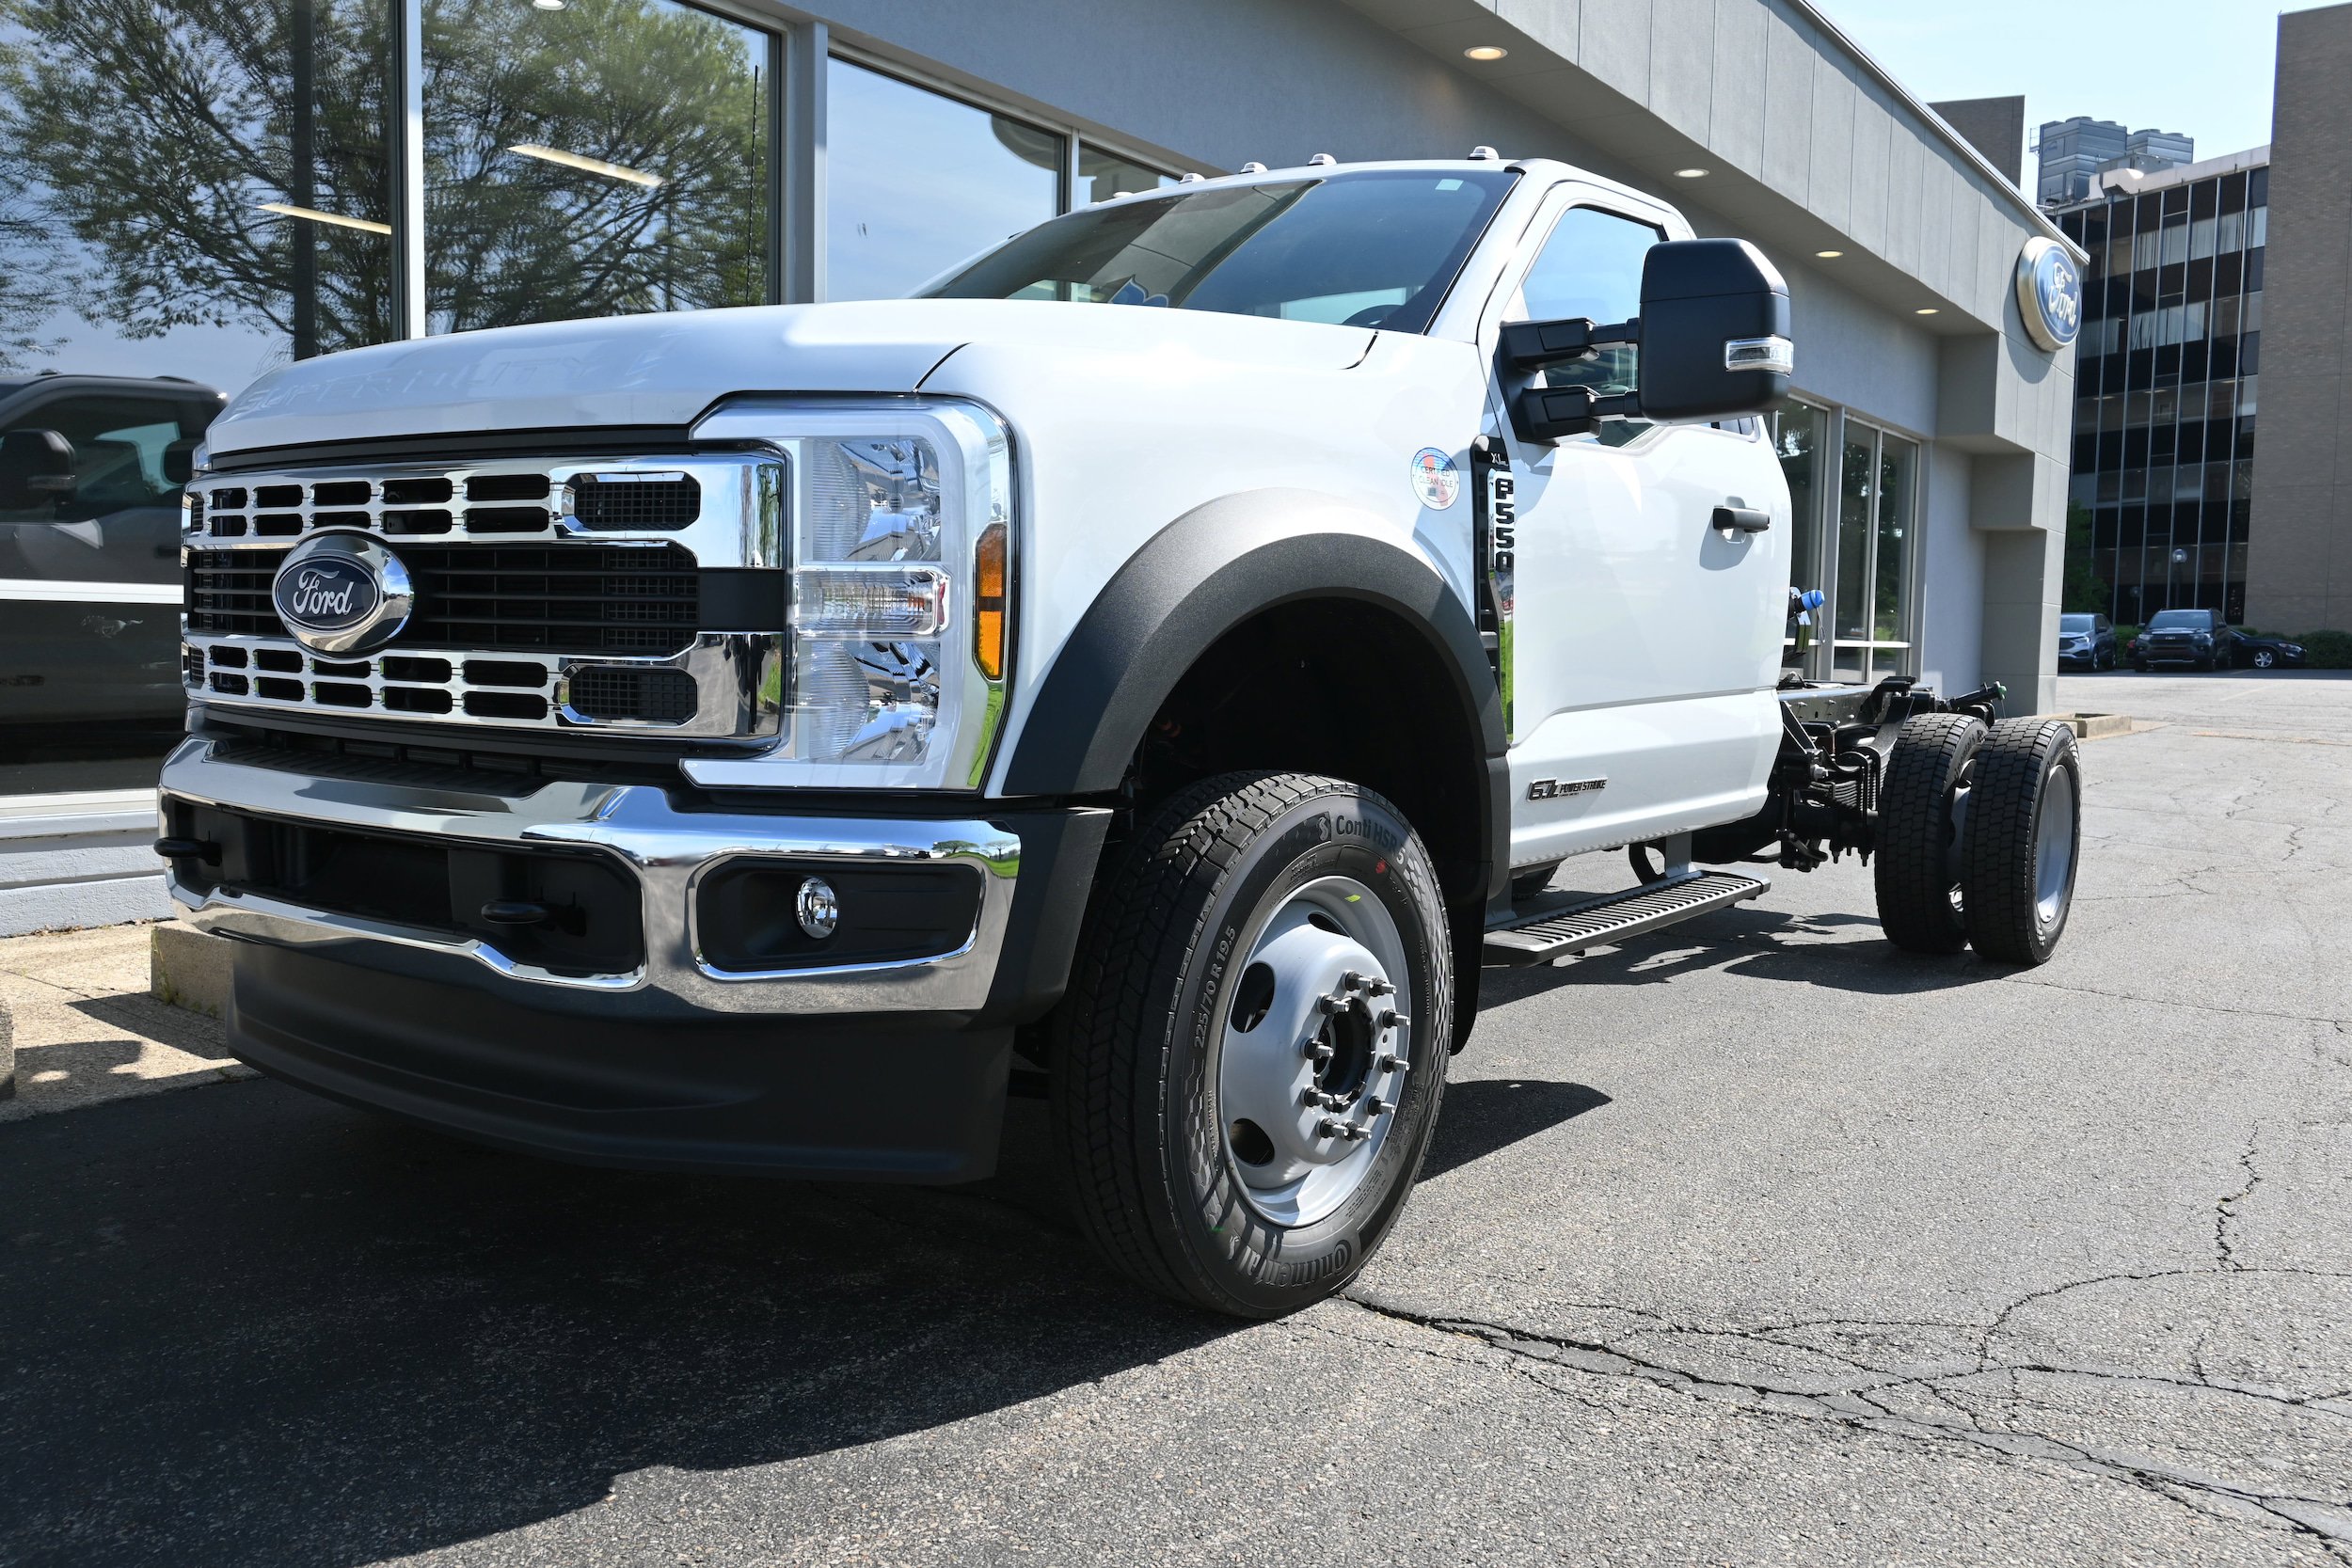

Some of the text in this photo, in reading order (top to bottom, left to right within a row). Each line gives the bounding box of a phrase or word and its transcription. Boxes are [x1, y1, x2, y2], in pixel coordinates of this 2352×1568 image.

[2048, 261, 2077, 327] Ford
[293, 567, 354, 616] Ford
[1336, 815, 1372, 839] Conti
[1194, 926, 1236, 1049] 225/70 R 19.5
[1237, 1239, 1353, 1288] Continental
